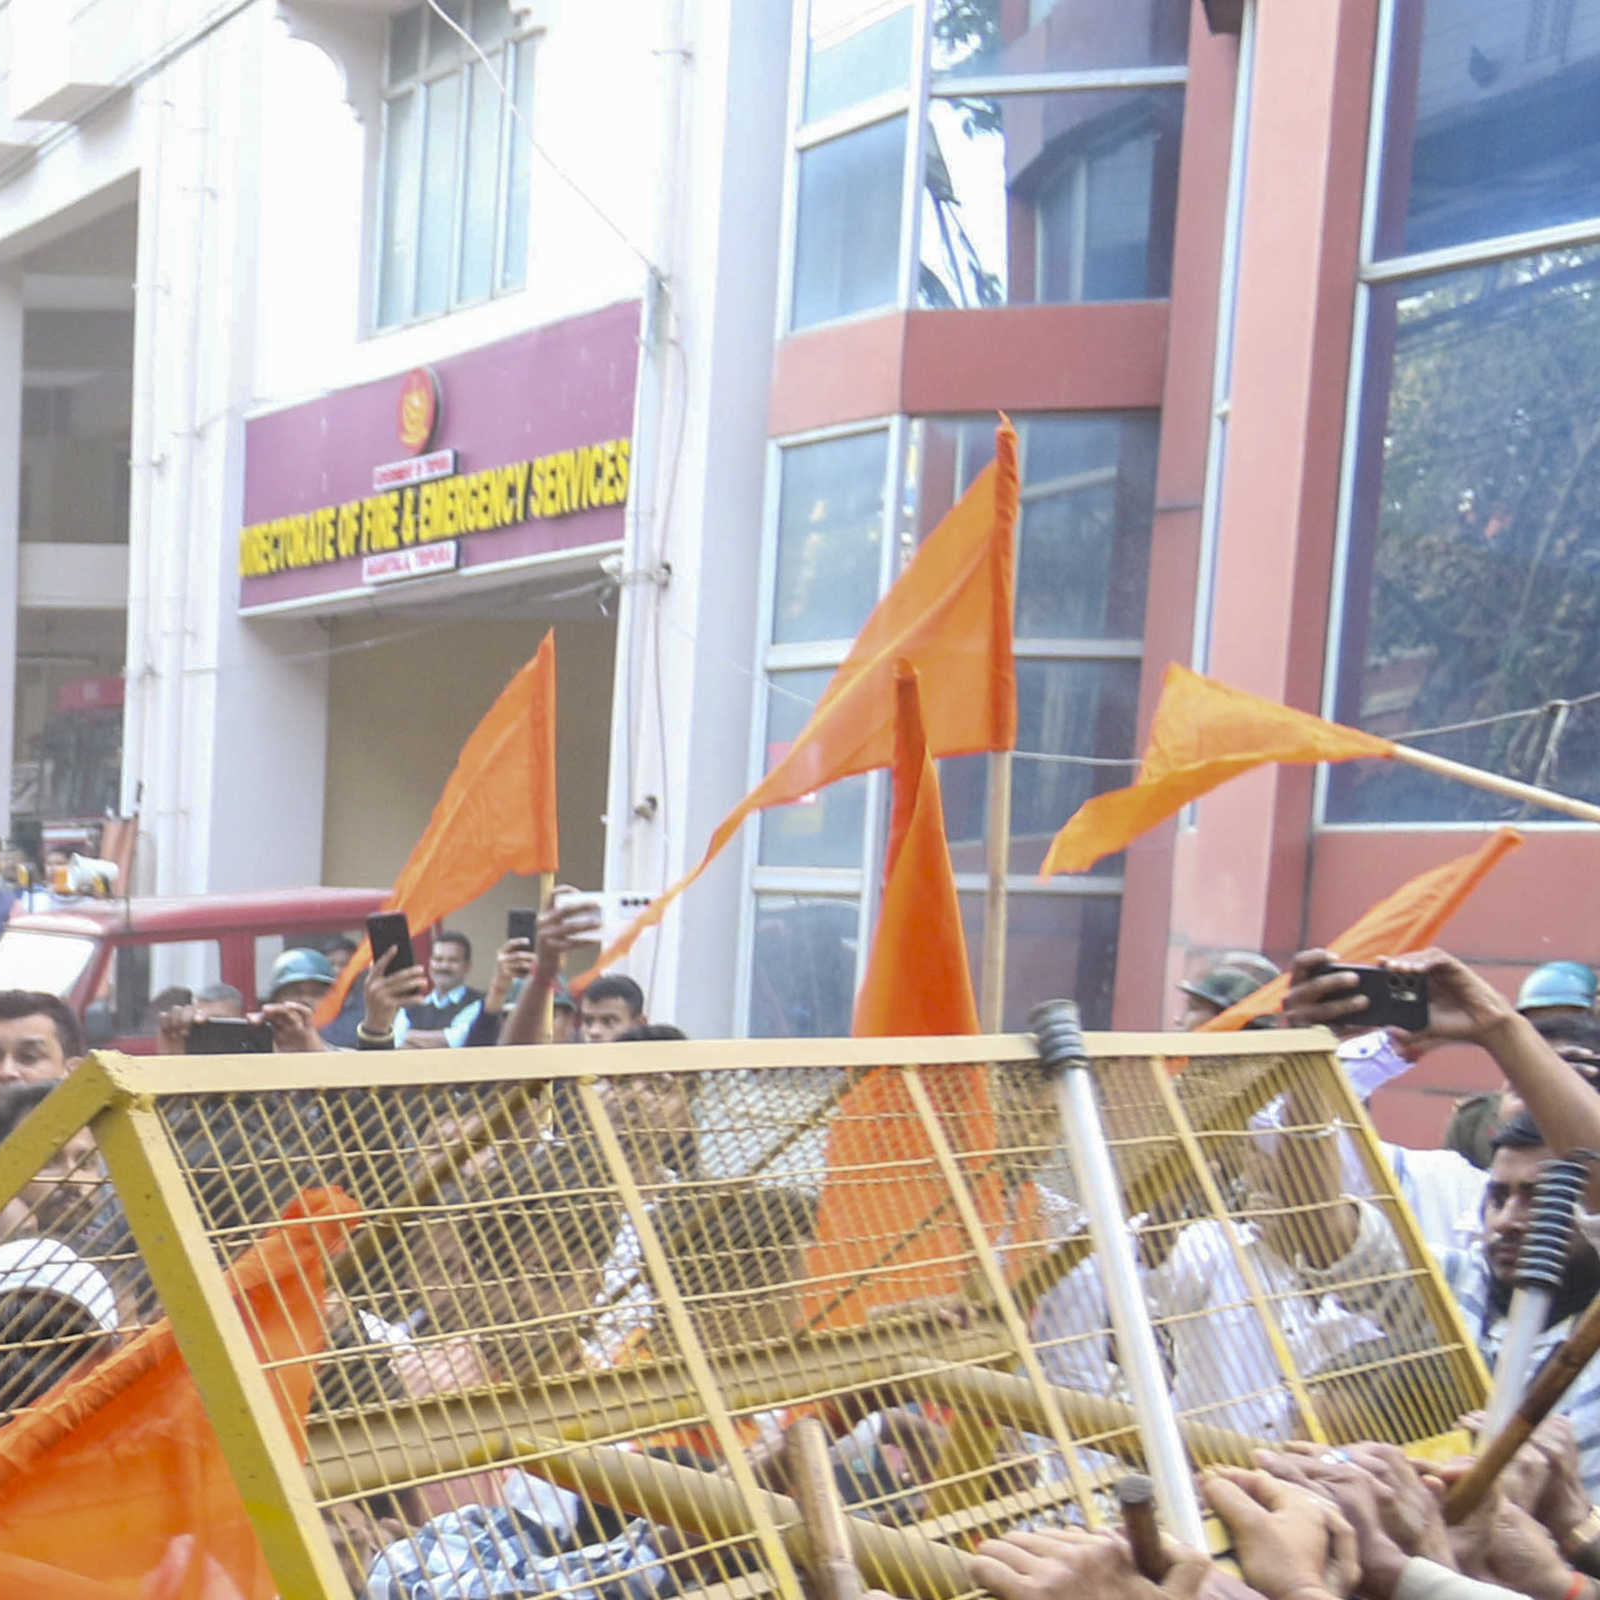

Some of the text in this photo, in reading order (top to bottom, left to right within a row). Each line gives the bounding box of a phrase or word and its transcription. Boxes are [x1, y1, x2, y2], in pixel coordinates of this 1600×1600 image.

[338, 499, 362, 558] OF
[362, 489, 400, 553] FIRE
[418, 459, 530, 542] EMERGENCY
[530, 437, 632, 518] SERVICES
